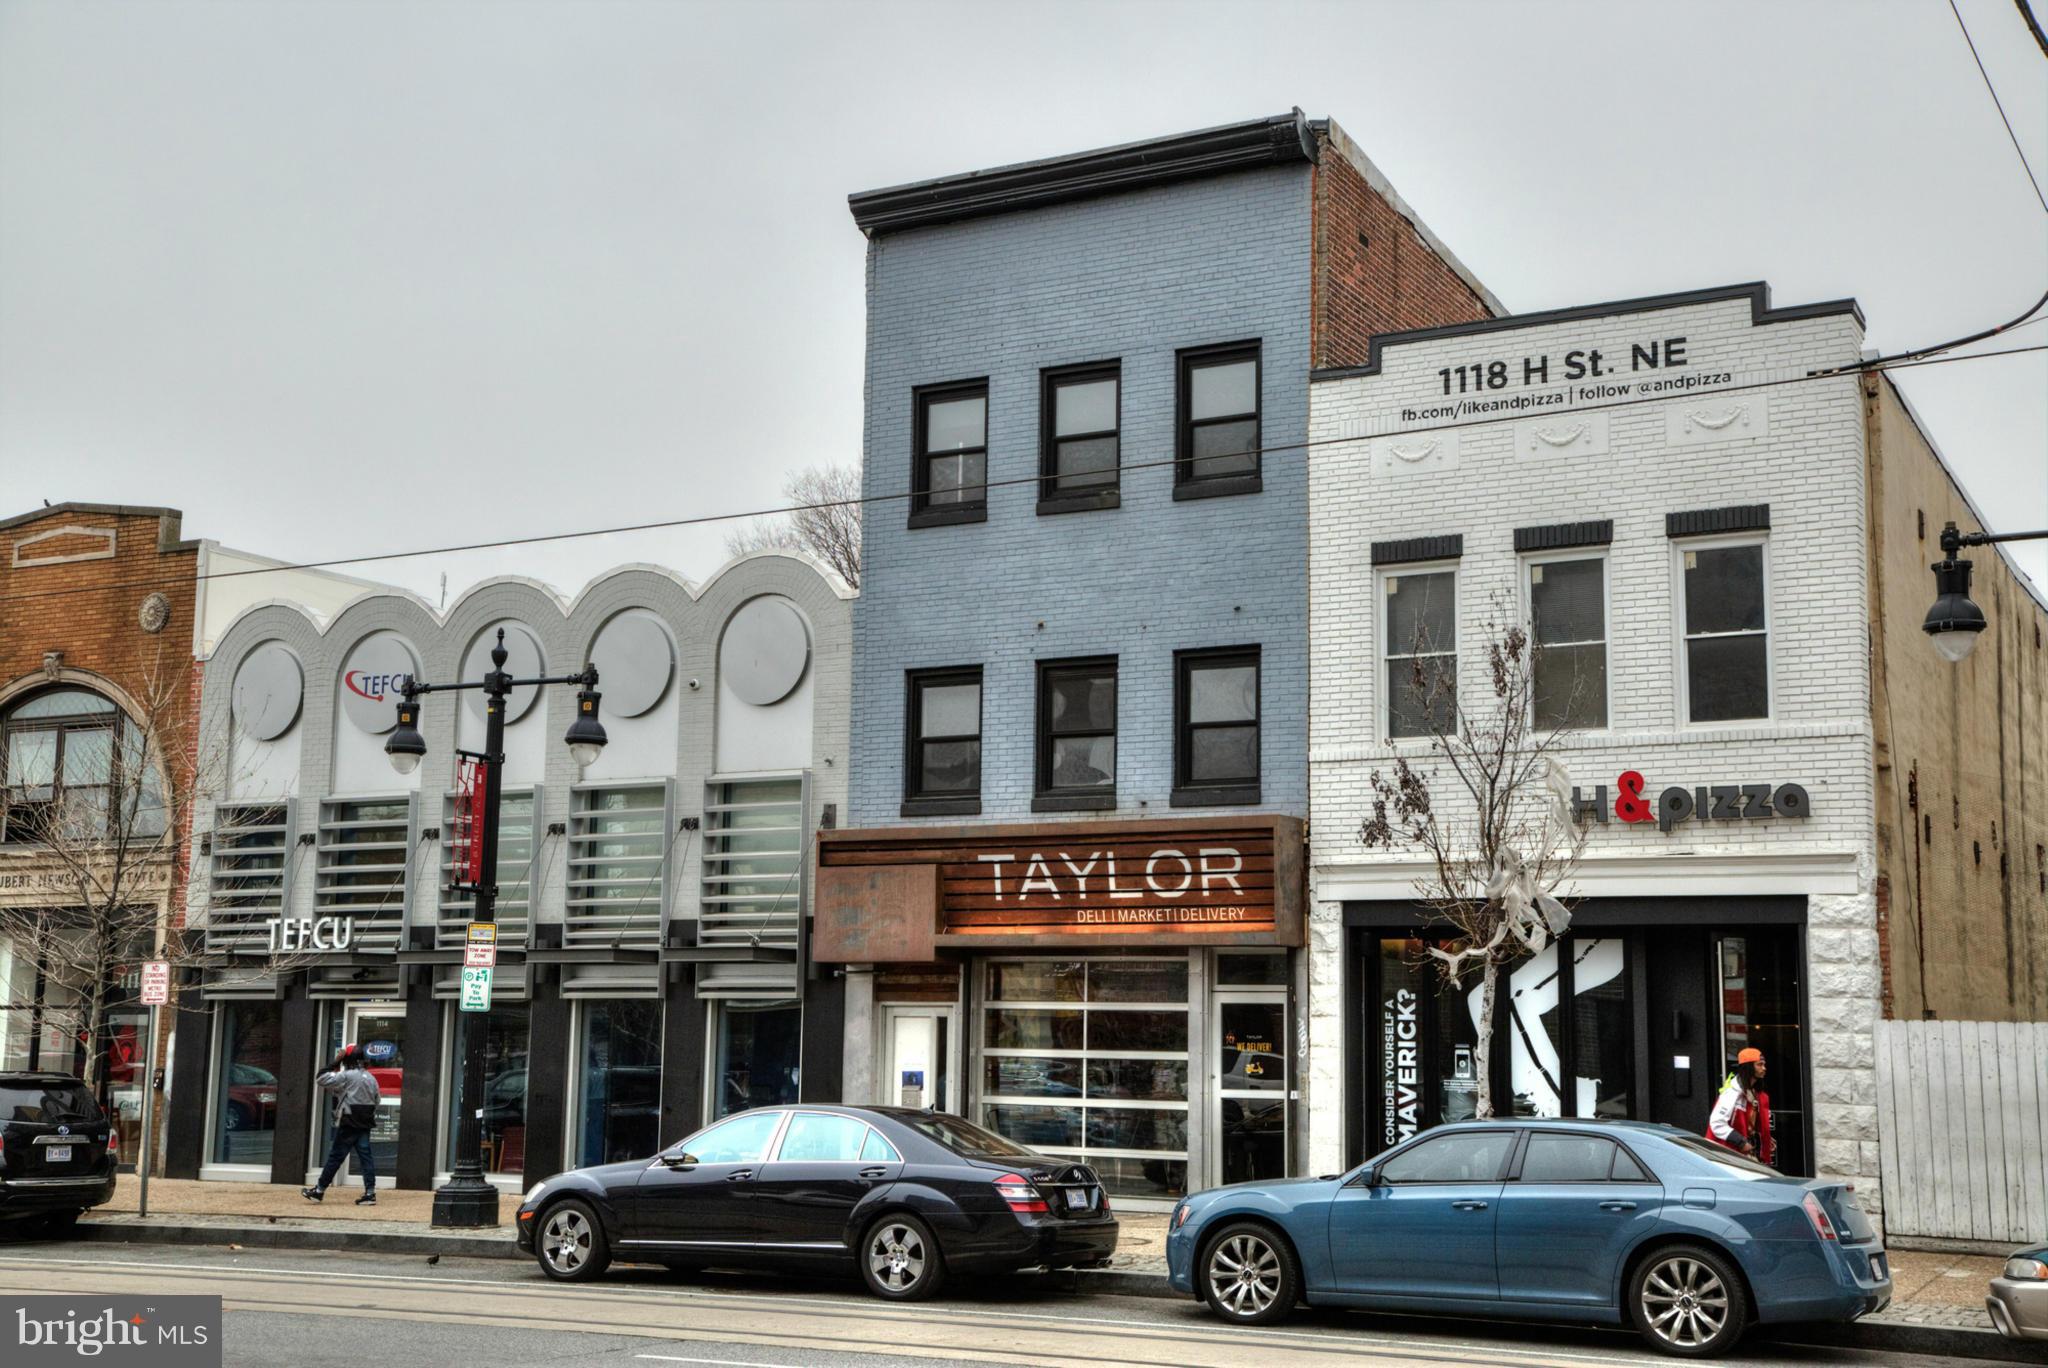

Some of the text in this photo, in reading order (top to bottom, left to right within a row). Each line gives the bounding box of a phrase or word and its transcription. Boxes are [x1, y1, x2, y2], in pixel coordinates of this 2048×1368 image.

[1438, 337, 1688, 395] 1118 H St. NE
[1402, 371, 1732, 422] fb.com/likeandpizza follow @andpizza
[977, 847, 1244, 901] TAYLOR
[266, 916, 352, 949] TEFCU
[1077, 907, 1246, 923] DELI MARKET DELIVERY
[1384, 999, 1395, 1145] CONSIDER YOURSELF A
[1397, 988, 1418, 1144] MAVERICK?
